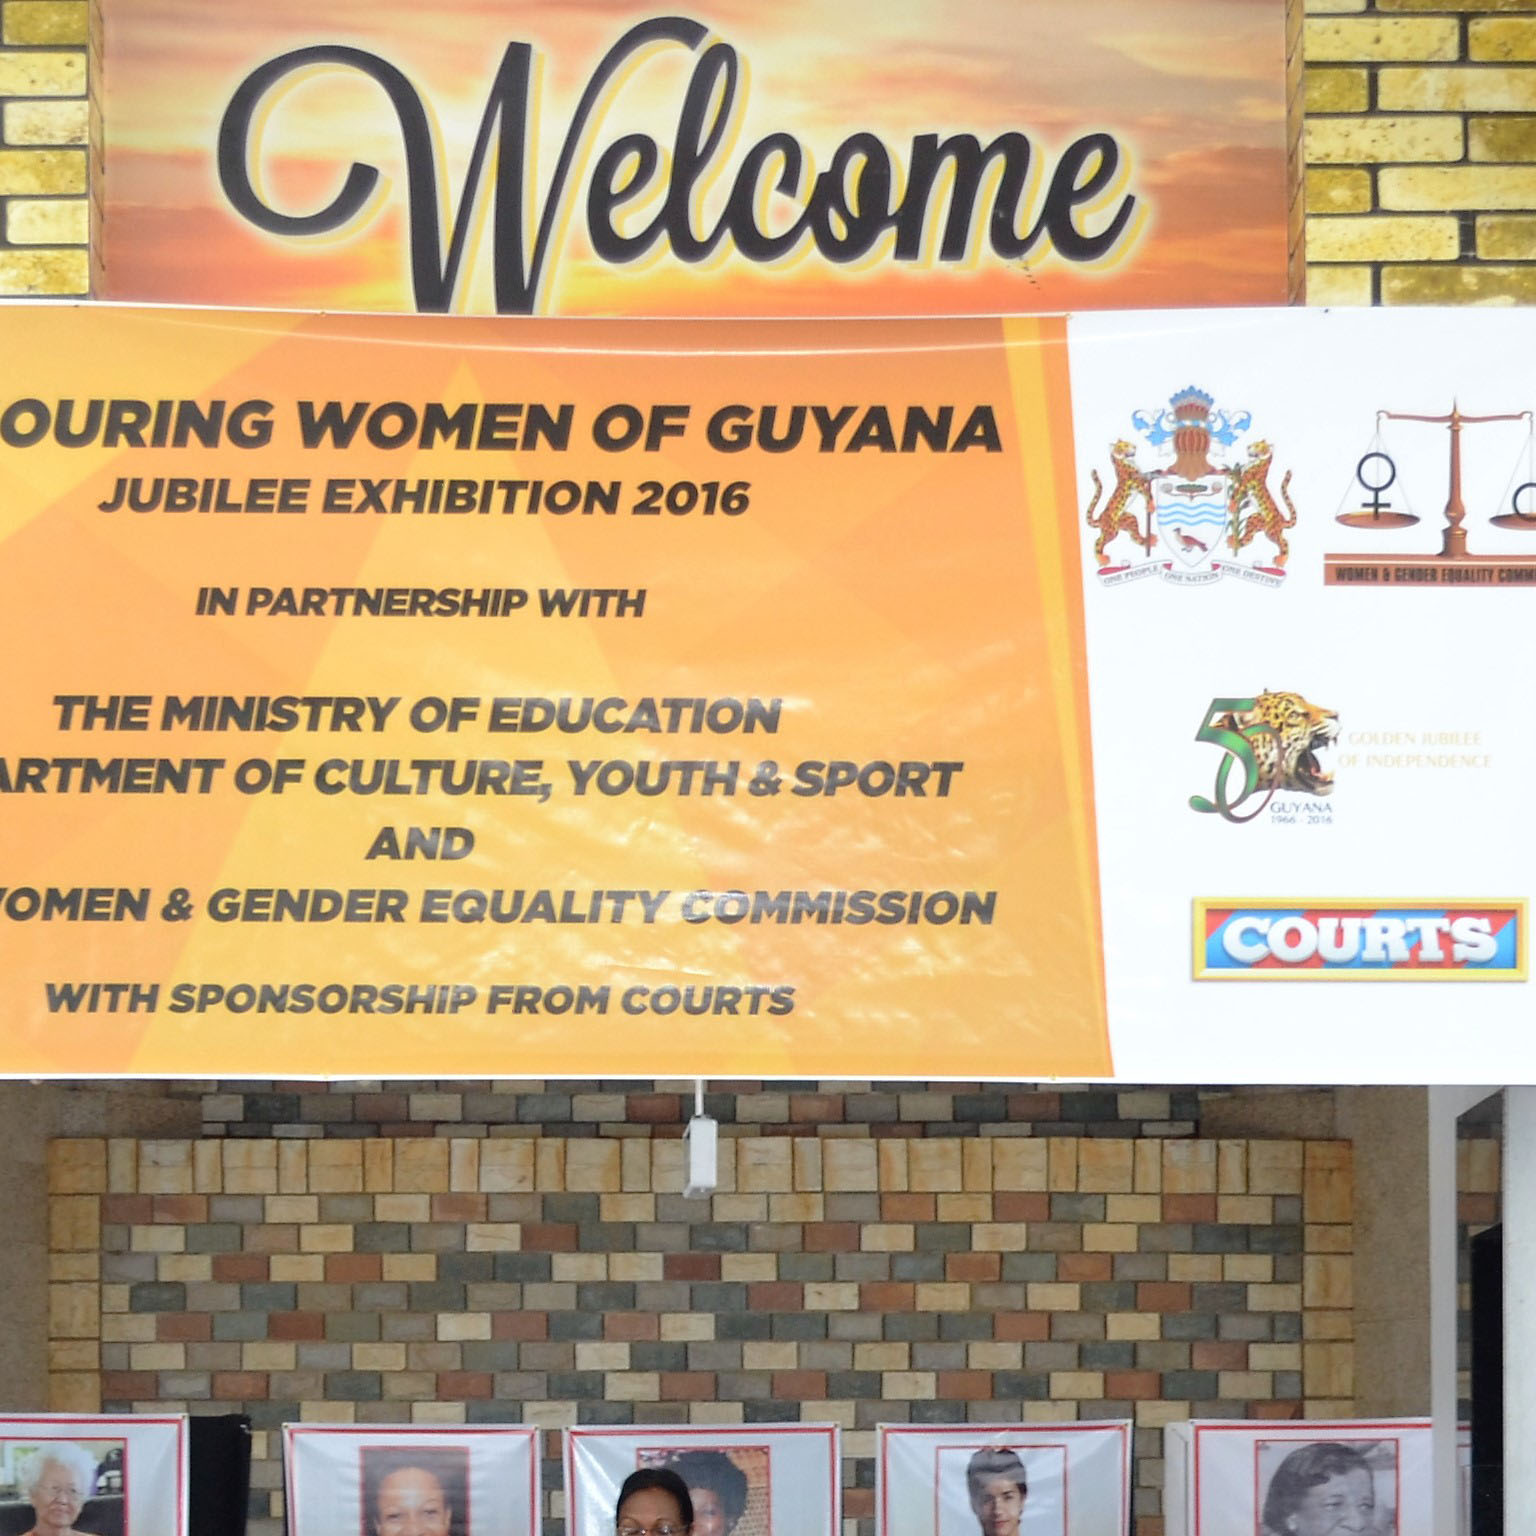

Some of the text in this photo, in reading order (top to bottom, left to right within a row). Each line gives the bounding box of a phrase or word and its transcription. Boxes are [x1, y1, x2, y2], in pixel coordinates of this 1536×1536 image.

[218, 16, 1137, 314] Welcome
[298, 402, 576, 451] WOMEN
[593, 404, 690, 452] OF
[707, 405, 1001, 452] GUYANA
[98, 478, 750, 515] JUBILEE EXHIBITION 2016
[1336, 567, 1378, 583] WOMEN
[1394, 567, 1437, 583] GENDER
[1441, 567, 1493, 583] EQUALITY
[196, 588, 646, 617] IN PARTNERSHIP WITH
[54, 696, 781, 733] THE MINISTRY OF EDUCATION
[1348, 732, 1482, 746] GOLDEN JUBILEE
[1338, 754, 1492, 768] OF INDEPENDENCE
[235, 759, 305, 794] OF
[315, 759, 551, 802] CULTURE,
[568, 761, 740, 796] YOUTH
[749, 761, 782, 796] &
[791, 761, 964, 797] SPORT
[1270, 802, 1333, 814] GUYANA
[365, 827, 474, 860] AND
[161, 888, 193, 921] &
[208, 888, 408, 922] GENDER
[420, 890, 668, 923] EQUALITY
[681, 890, 997, 925] COMMISSION
[1222, 917, 1497, 963] COURTS
[46, 984, 795, 1015] WITH SPONSORSHIP FROM COURTS
